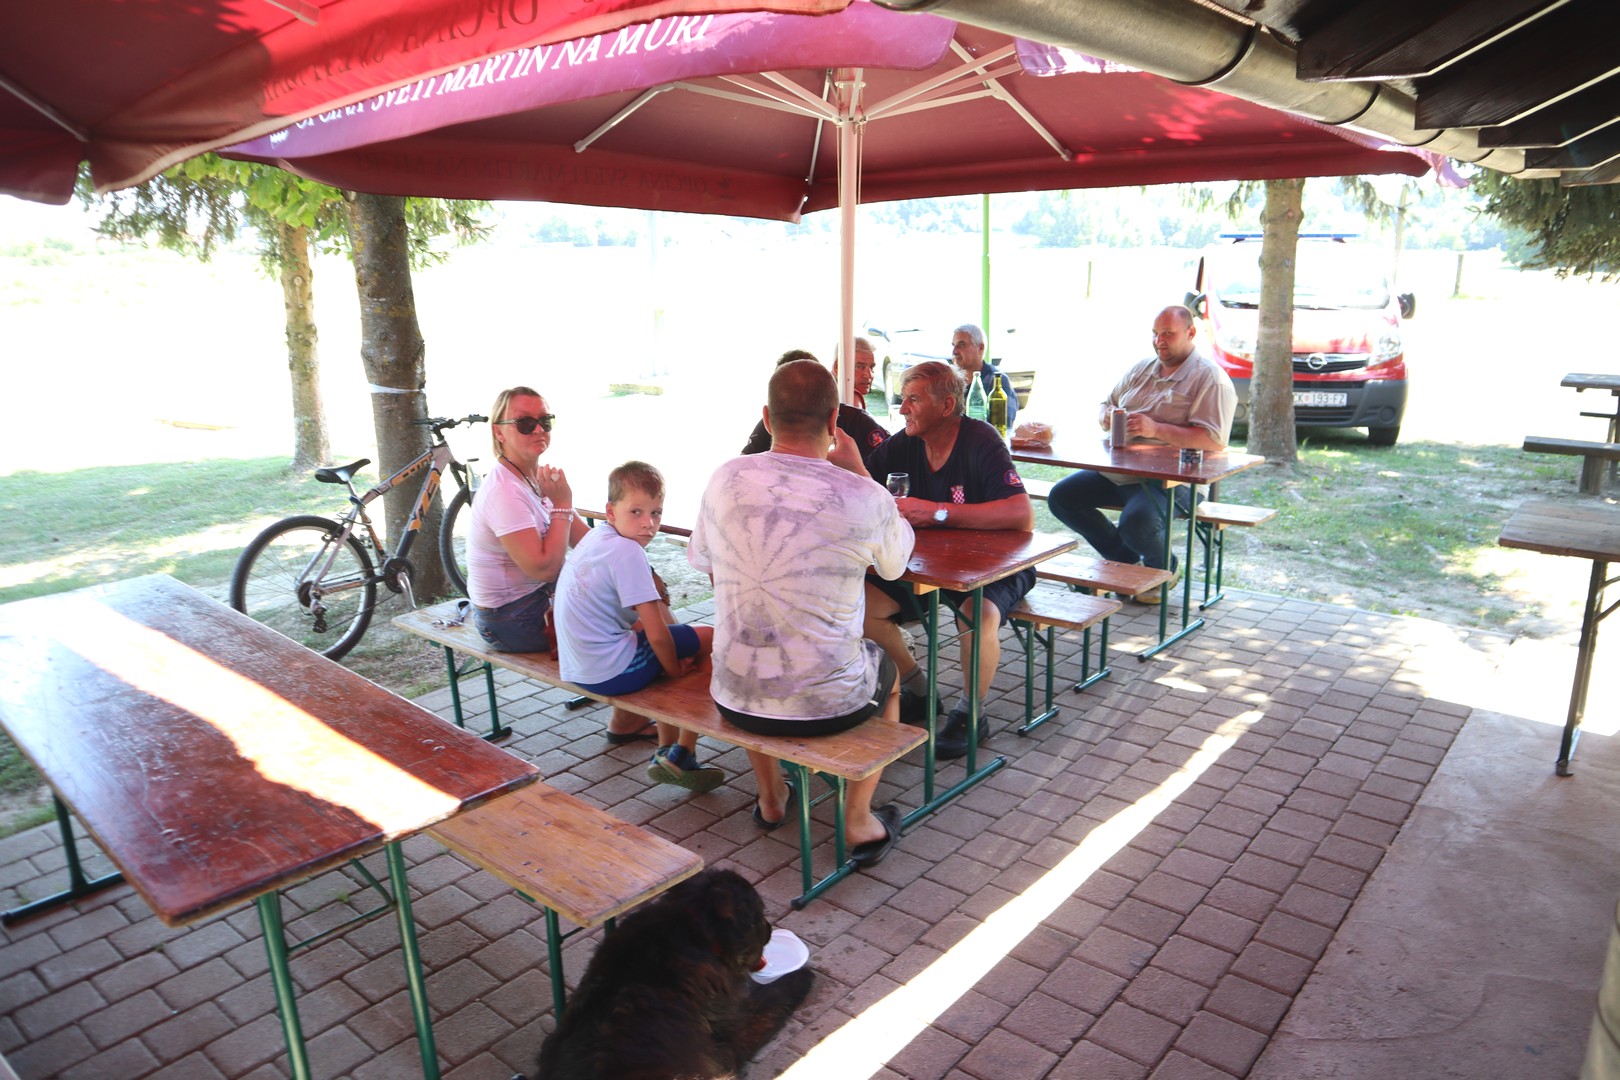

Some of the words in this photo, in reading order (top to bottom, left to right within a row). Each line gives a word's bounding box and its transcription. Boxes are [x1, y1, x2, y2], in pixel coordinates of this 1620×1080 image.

[436, 45, 553, 95] MARTIN
[551, 34, 602, 70] NA
[605, 14, 714, 58] MURI
